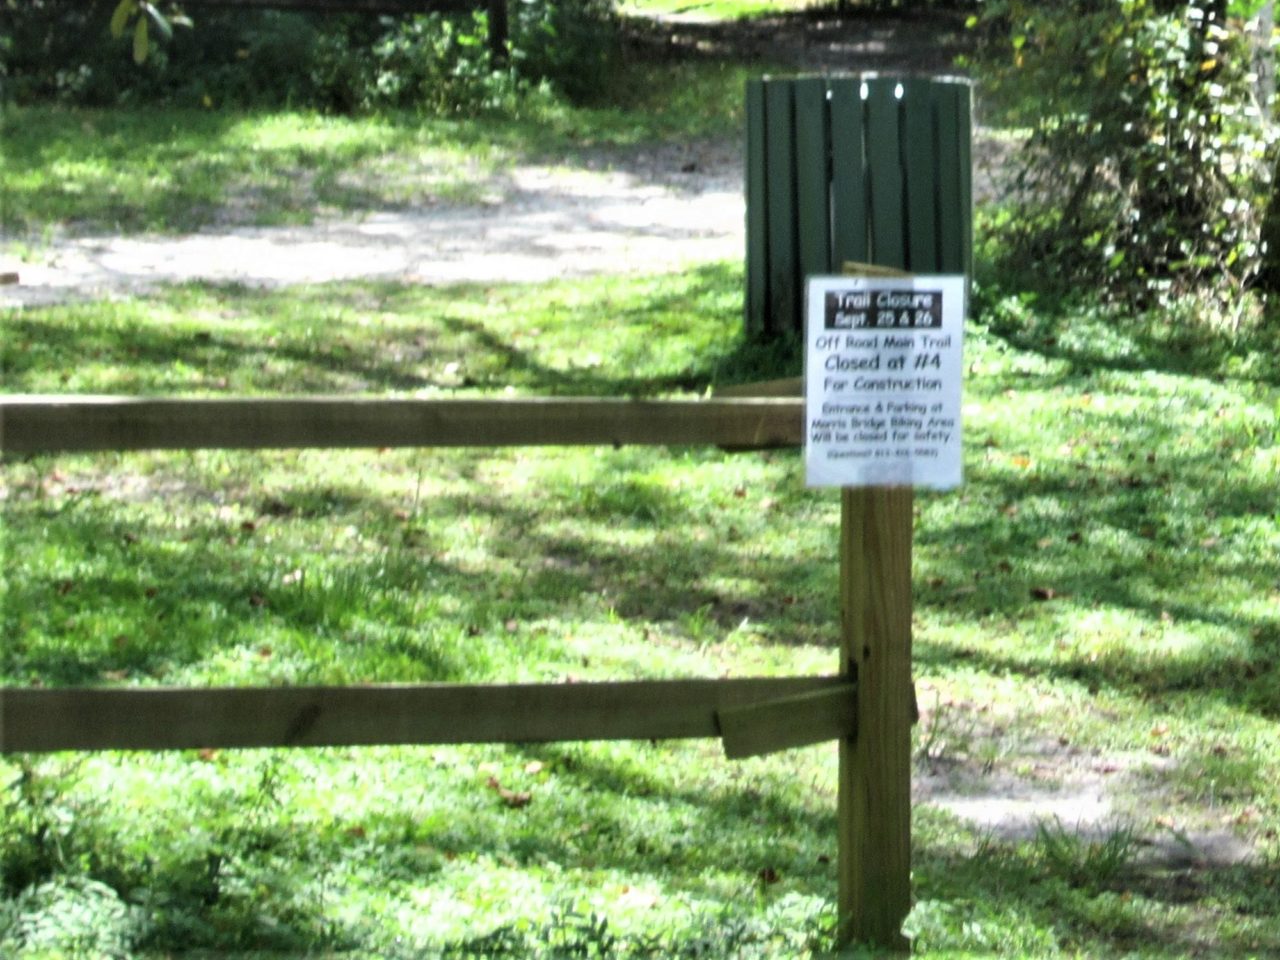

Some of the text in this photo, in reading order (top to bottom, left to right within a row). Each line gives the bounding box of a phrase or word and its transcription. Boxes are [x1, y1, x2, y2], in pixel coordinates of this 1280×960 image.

[834, 291, 933, 308] Trail Closure
[834, 311, 870, 329] Sept.
[915, 311, 933, 327] 26
[816, 335, 951, 350] Off Road Main Trail
[824, 353, 941, 371] Closed at #4
[824, 376, 942, 391] For Construction
[822, 402, 870, 414] Entrance
[886, 401, 926, 415] Parking
[931, 402, 943, 413] at
[811, 417, 954, 430] Morris Bridge Biking Area
[812, 431, 831, 443] Will
[835, 431, 848, 442] be
[854, 431, 888, 442] closed
[892, 430, 909, 442] for
